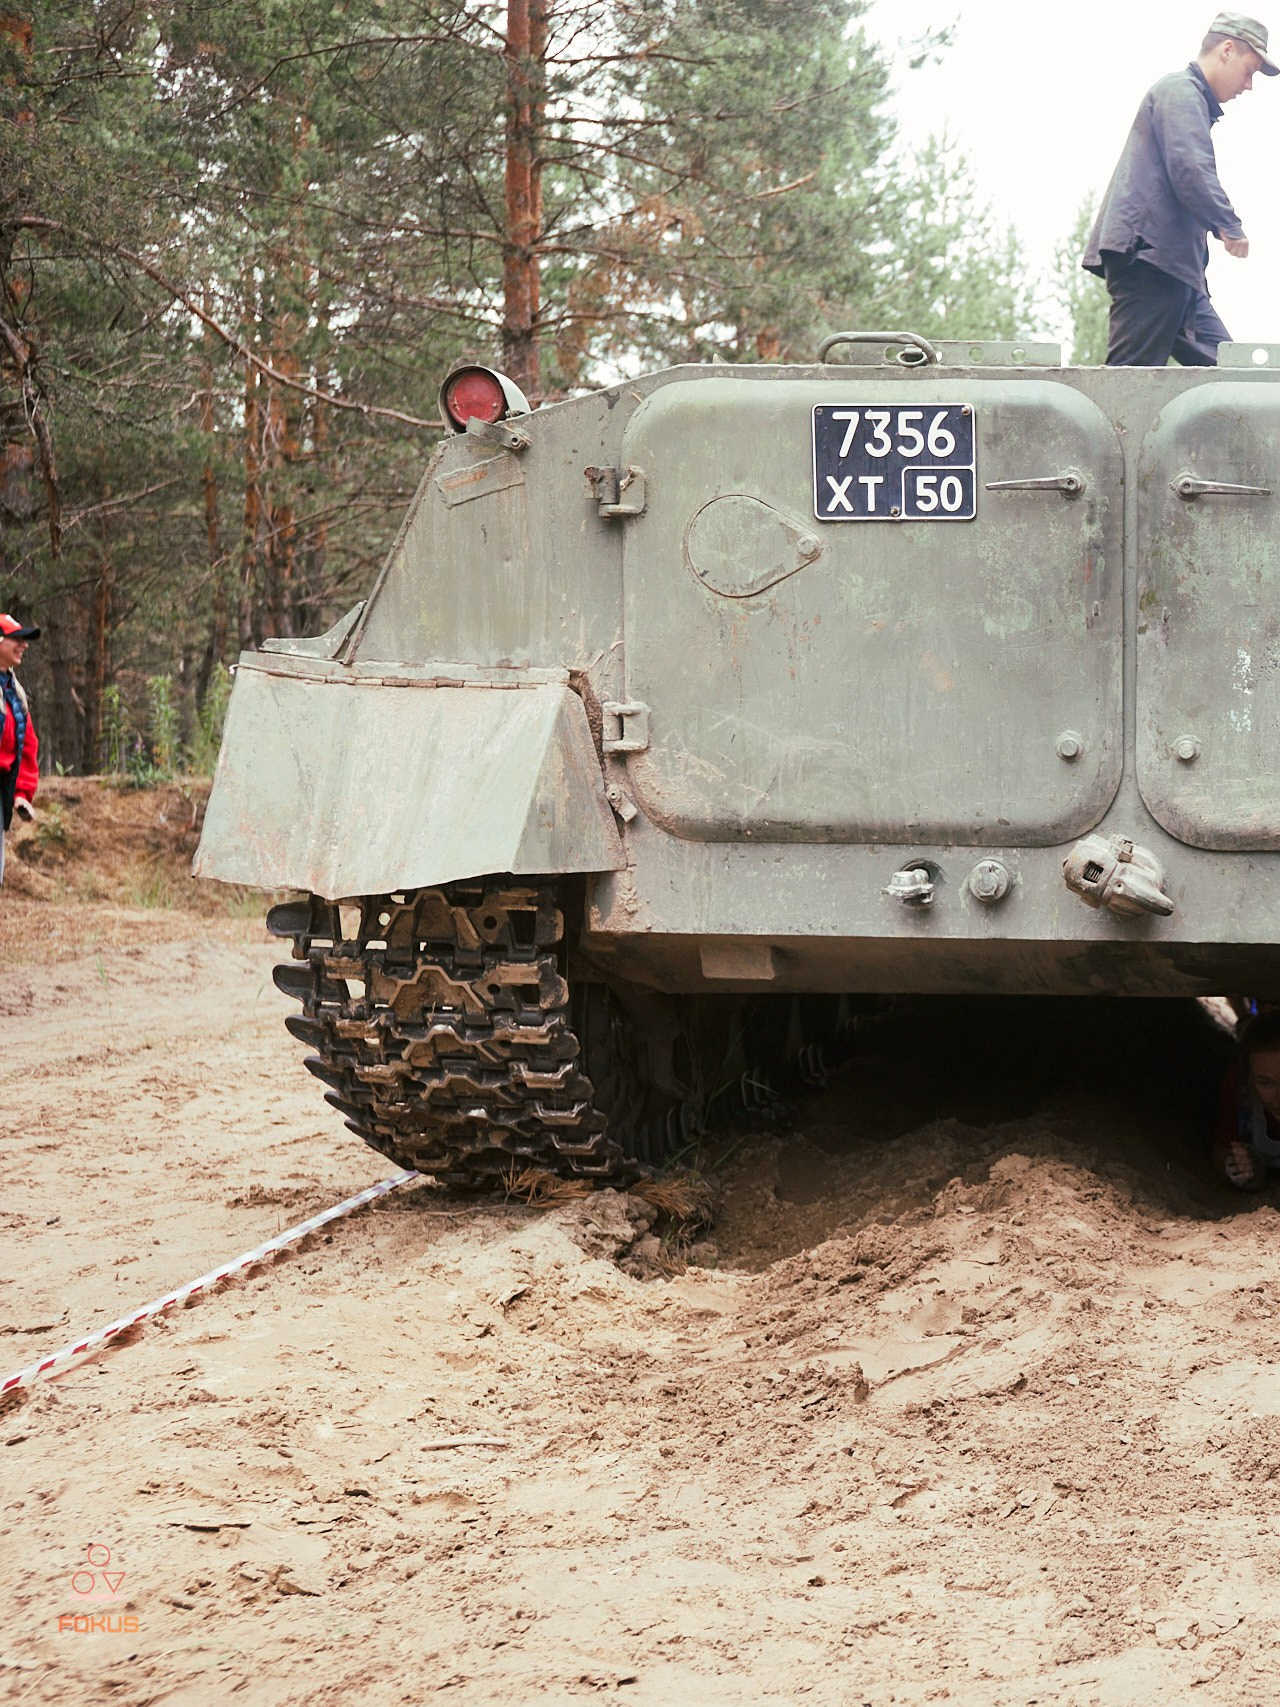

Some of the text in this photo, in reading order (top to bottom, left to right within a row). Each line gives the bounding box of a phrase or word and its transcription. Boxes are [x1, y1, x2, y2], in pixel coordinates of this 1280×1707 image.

[832, 411, 956, 458] 7356
[826, 476, 963, 512] ХТ 50
